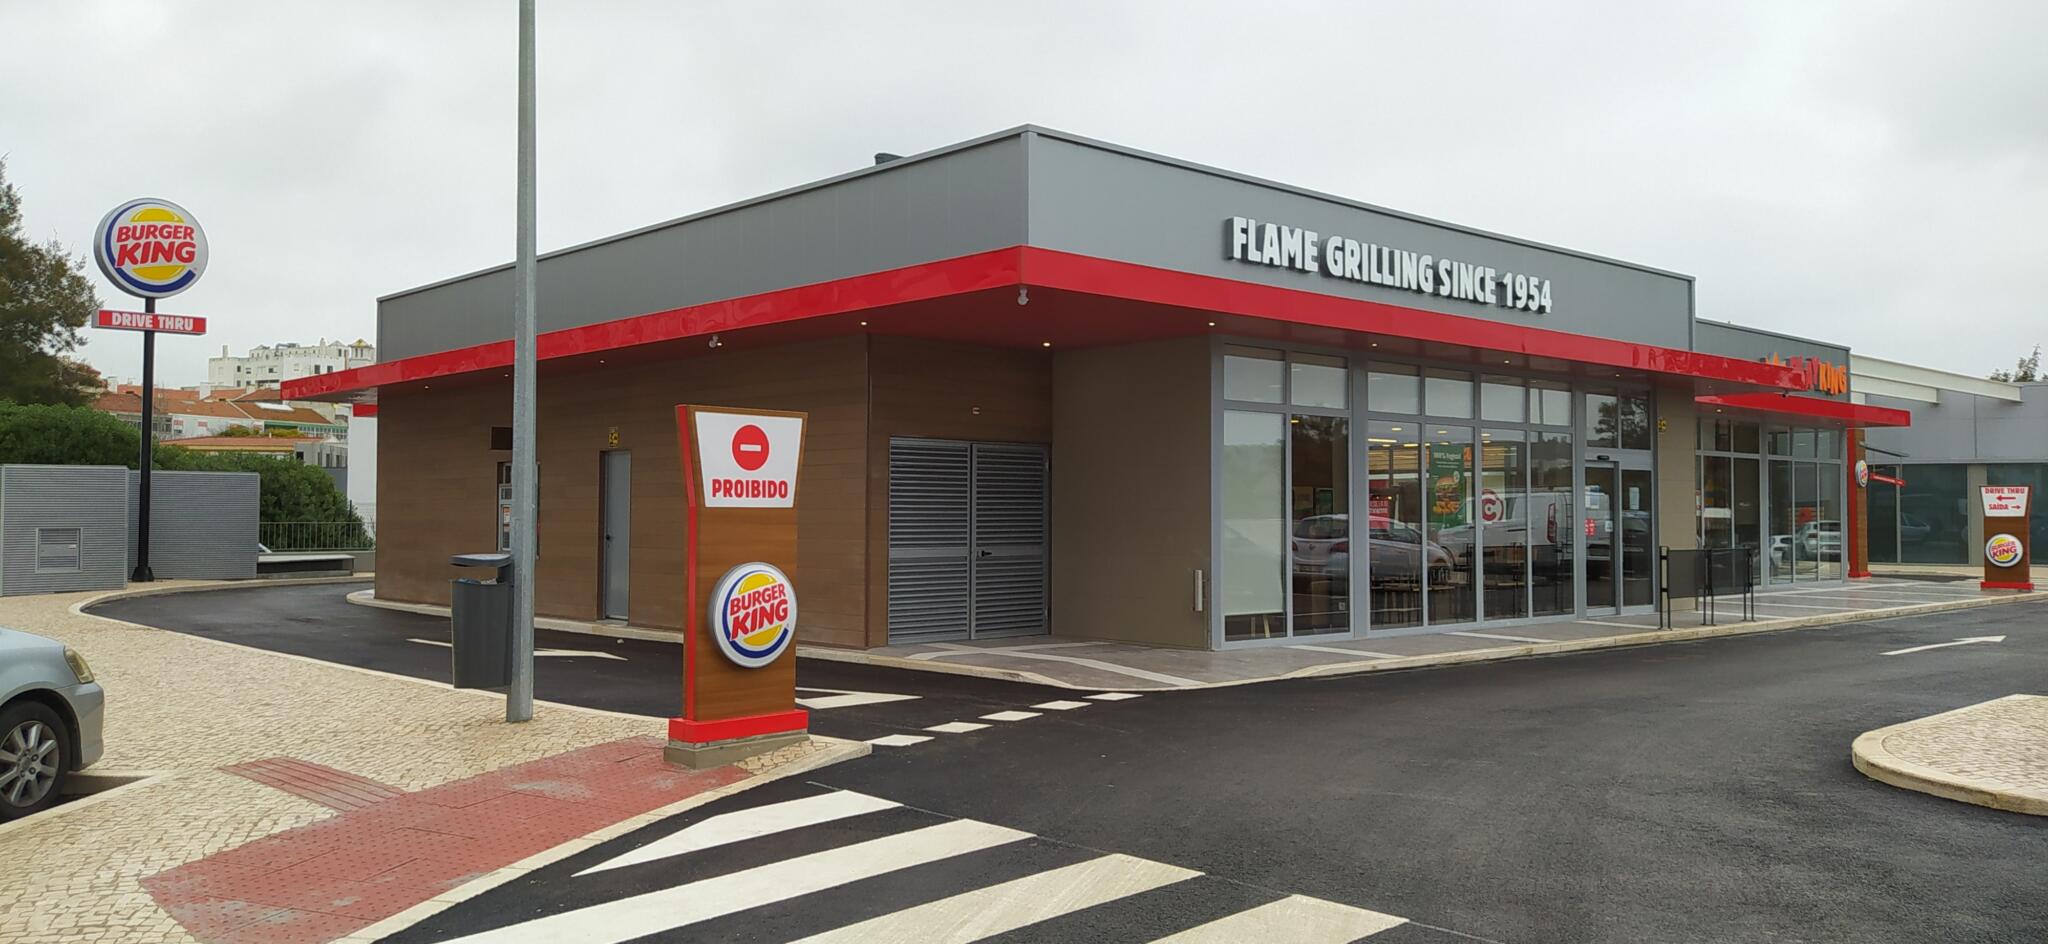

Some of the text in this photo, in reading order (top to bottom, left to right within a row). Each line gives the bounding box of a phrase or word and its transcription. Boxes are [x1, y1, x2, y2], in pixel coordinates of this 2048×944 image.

[116, 224, 195, 243] BURGER
[116, 240, 197, 267] KING
[1231, 215, 1553, 314] FLAME GRILLING SINCE 1954
[111, 312, 193, 331] DRIVE THRU
[711, 478, 788, 499] PROIBIDO
[1988, 502, 2009, 510] SAÍDA
[1991, 540, 2016, 550] BURGER
[1991, 545, 2017, 559] KING
[729, 583, 786, 617] BURGER
[729, 599, 789, 641] KING
